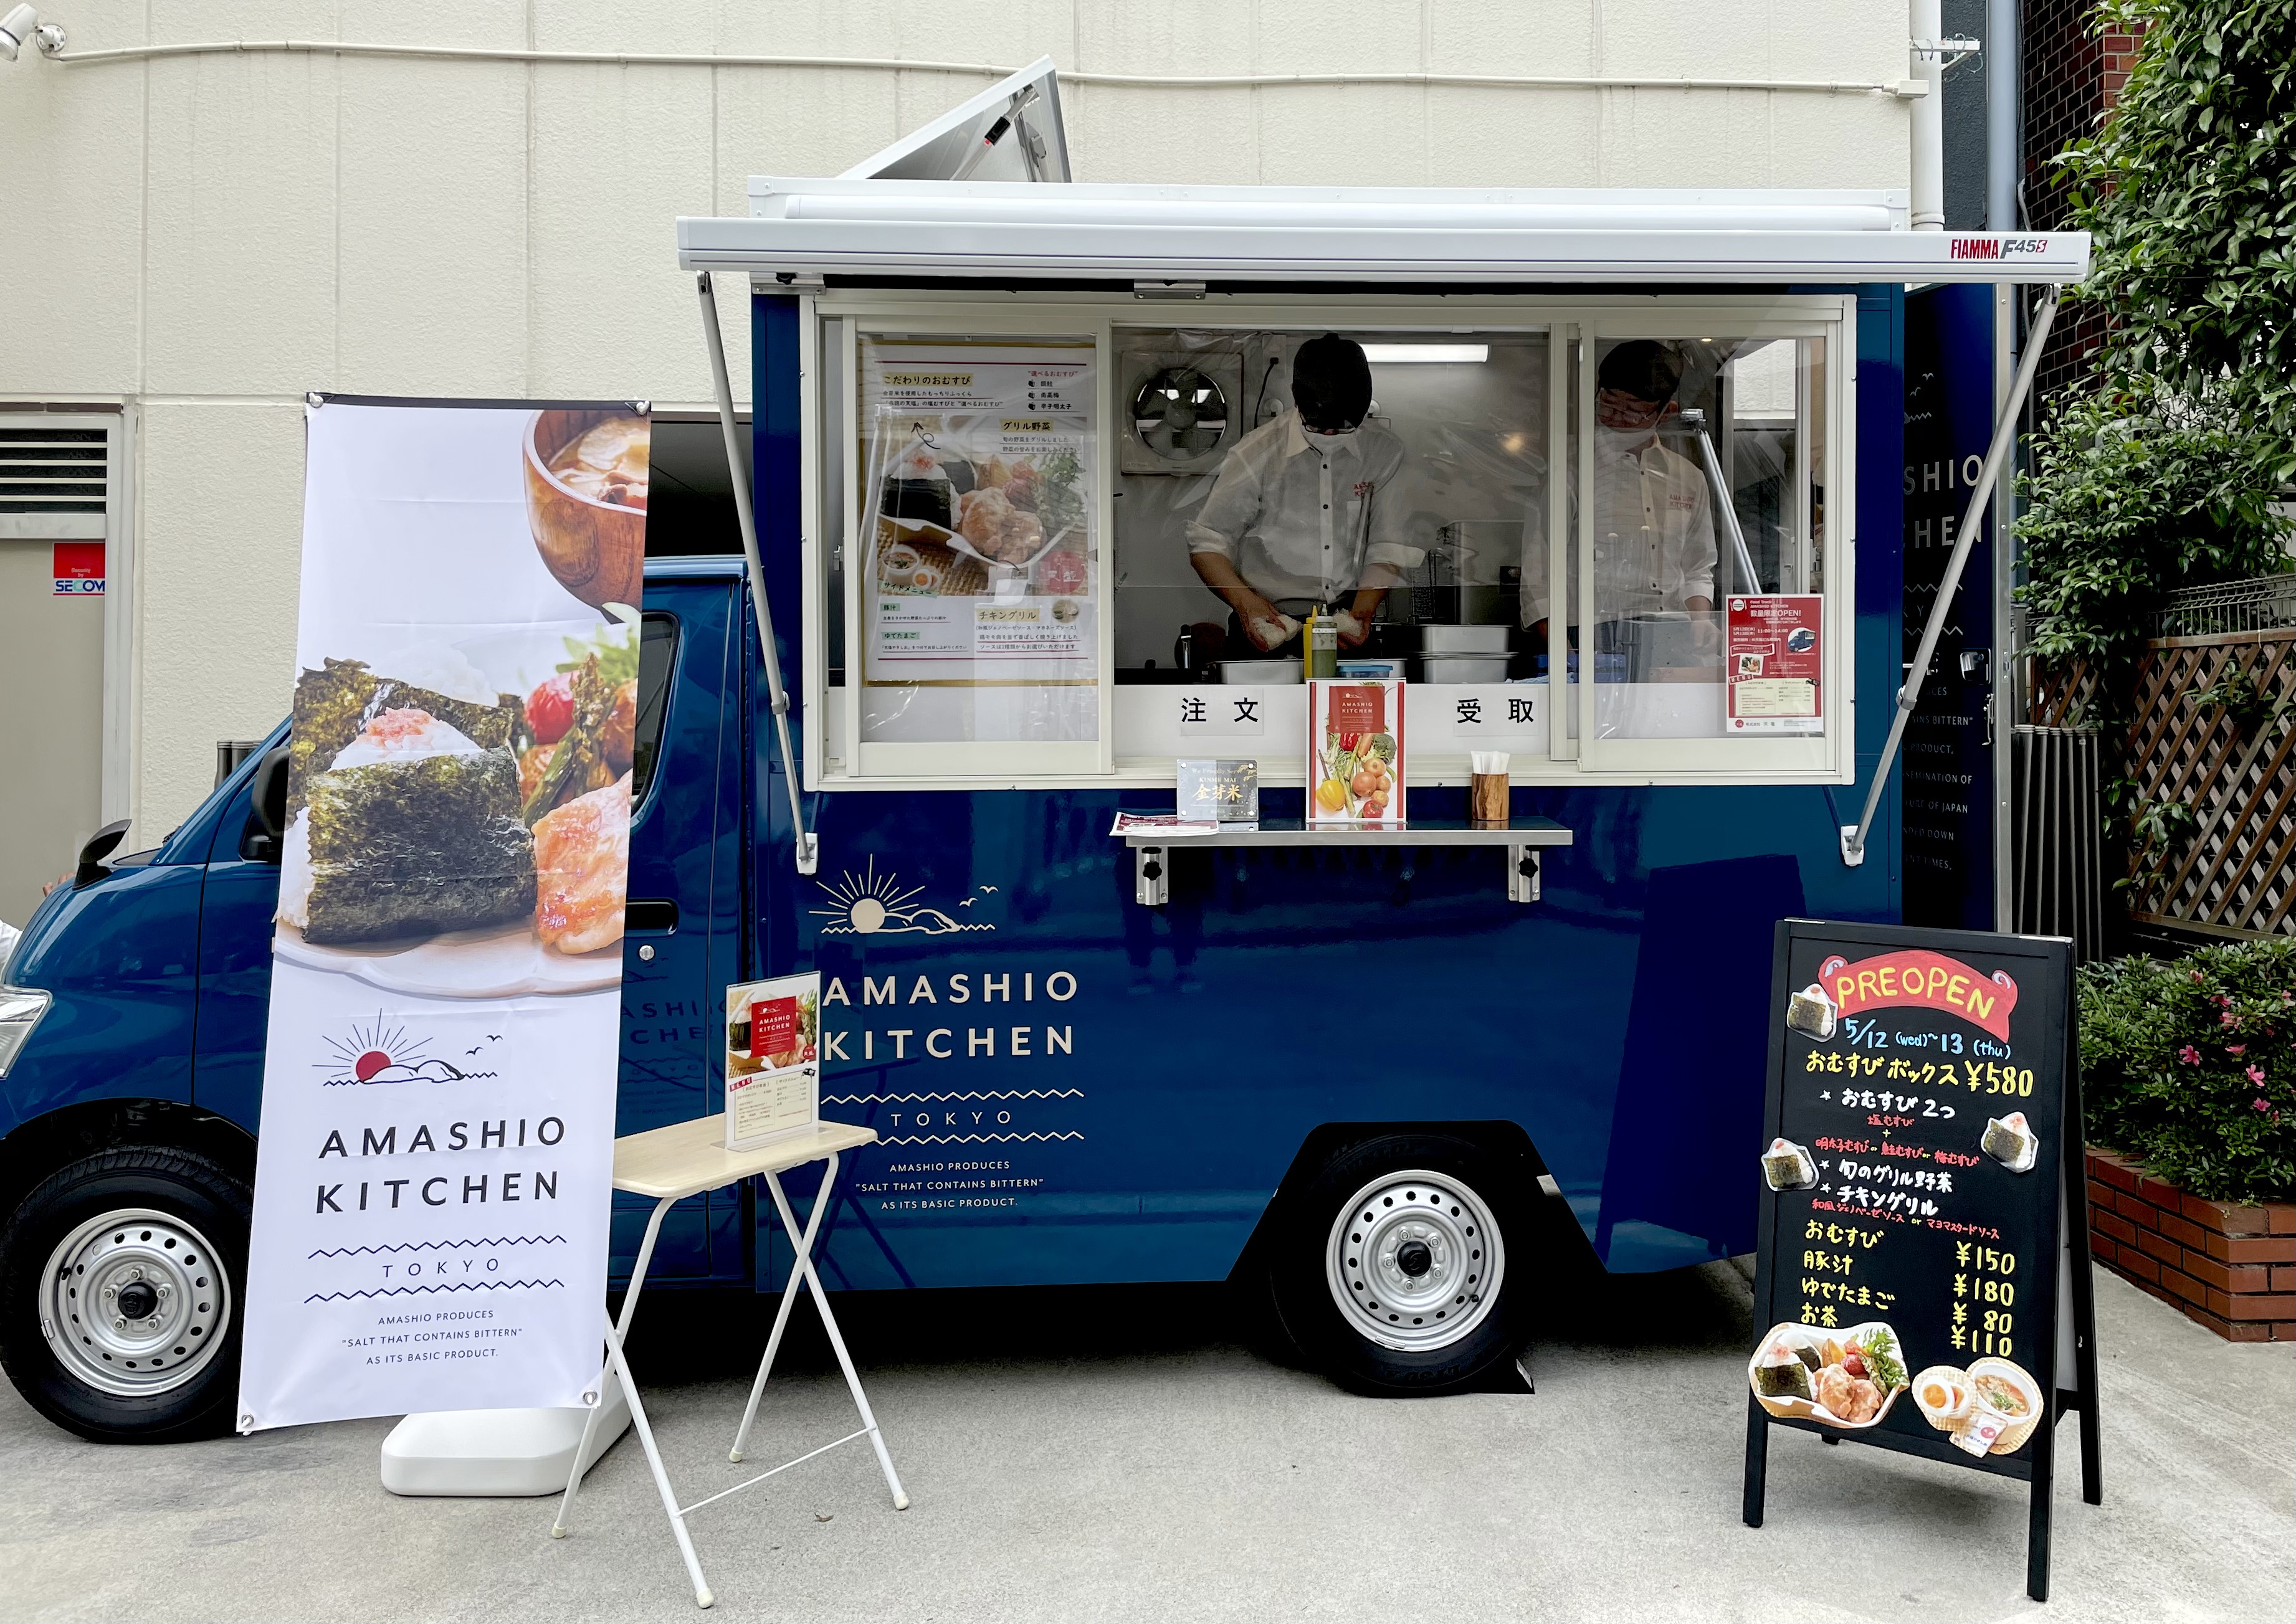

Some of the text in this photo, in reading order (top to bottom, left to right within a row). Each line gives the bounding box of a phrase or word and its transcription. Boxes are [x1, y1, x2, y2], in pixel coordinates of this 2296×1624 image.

[1951, 239, 1998, 259] FIAMMA
[884, 376, 971, 385] こだわりのおむすび
[1003, 421, 1051, 431] グリル野菜
[55, 580, 105, 592] SECOM
[979, 610, 1037, 620] チキングリル
[1181, 696, 1259, 723] 注文
[1456, 698, 1535, 724] 受取
[1960, 775, 1973, 784] OF
[1191, 784, 1244, 801] 金芽米
[1942, 802, 1968, 814] JAPAN
[1928, 829, 1955, 841] DOWN
[822, 971, 1077, 1007] AMASHIO
[758, 1022, 790, 1032] KITCHEN
[759, 1015, 791, 1025] AMASHIO
[824, 1025, 1072, 1061] KITCHEN
[1845, 1018, 1889, 1050] 5/12
[1941, 1033, 1964, 1054] 13
[1973, 1039, 2011, 1060] (thu)
[1964, 1060, 2034, 1097] ¥580
[890, 1111, 1011, 1127] TOKYO
[1867, 1113, 1915, 1128] 塩むすび
[318, 1116, 565, 1159] AMASHIO
[1815, 1136, 1870, 1154] 明太子むすび
[1880, 1141, 1924, 1159] 鮭むすび
[1934, 1150, 1979, 1167] 梅むすび
[890, 1161, 1010, 1172] AMASHIO PRODUCES
[893, 1182, 923, 1192] THAT
[926, 1179, 986, 1190] CONTAINS
[1839, 1159, 1953, 1194] 旬のグリル野菜
[316, 1171, 558, 1213] KITCHEN
[1836, 1185, 1938, 1216] チキングリル
[881, 1197, 1019, 1210] AS ITS BASIC PRODUCT.
[1926, 1218, 2000, 1240] マヨマスタードソース
[1805, 1218, 2015, 1275] おむすび ¥150
[382, 1258, 499, 1278] TOKYO
[1804, 1250, 2014, 1307] 豚汁 ¥180
[1801, 1276, 1895, 1310] ゆでたまご
[378, 1309, 494, 1326] AMASHIO PRODUCES
[380, 1334, 411, 1345] THAT
[414, 1331, 470, 1342] CONTAINS
[1800, 1301, 2013, 1357] お茶 ¥110
[366, 1348, 498, 1365] AS ITS BASIC PRODUCT.
